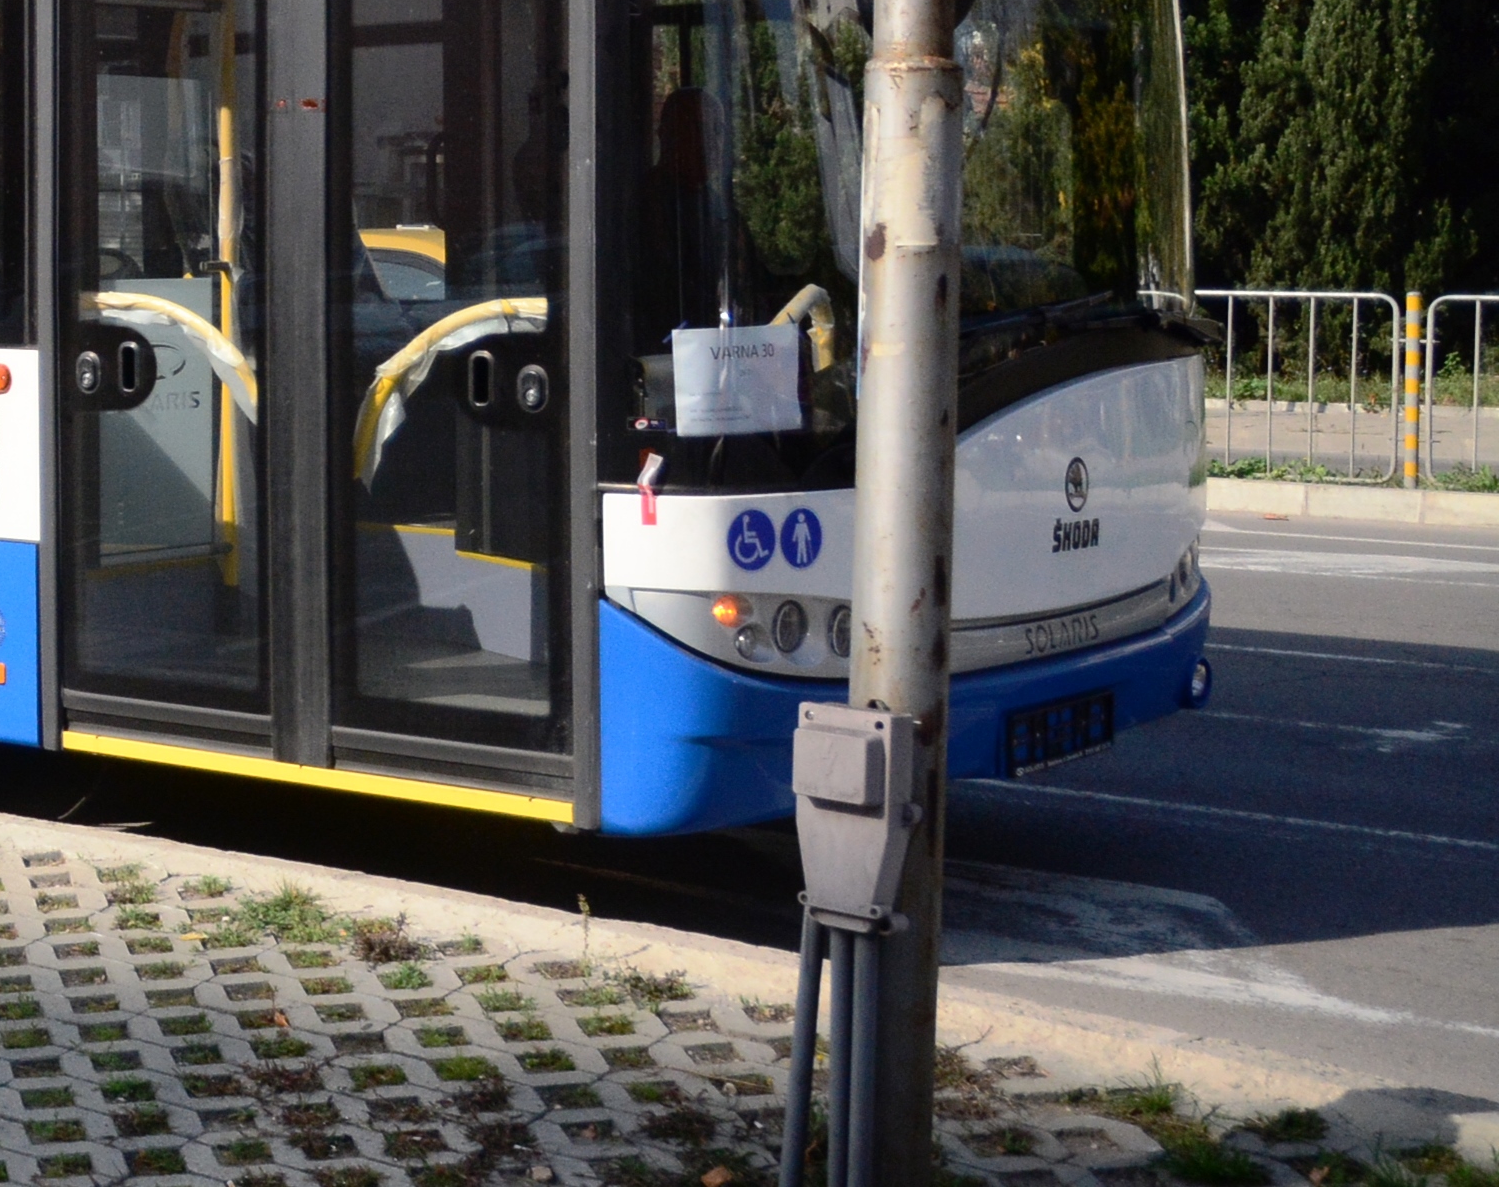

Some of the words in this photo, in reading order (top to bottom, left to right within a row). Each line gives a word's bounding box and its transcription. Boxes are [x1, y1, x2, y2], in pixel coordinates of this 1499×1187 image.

[710, 345, 759, 360] VARNA
[762, 343, 775, 358] 30
[1052, 517, 1100, 553] ŠKODA
[1025, 614, 1100, 655] SOLARIS
